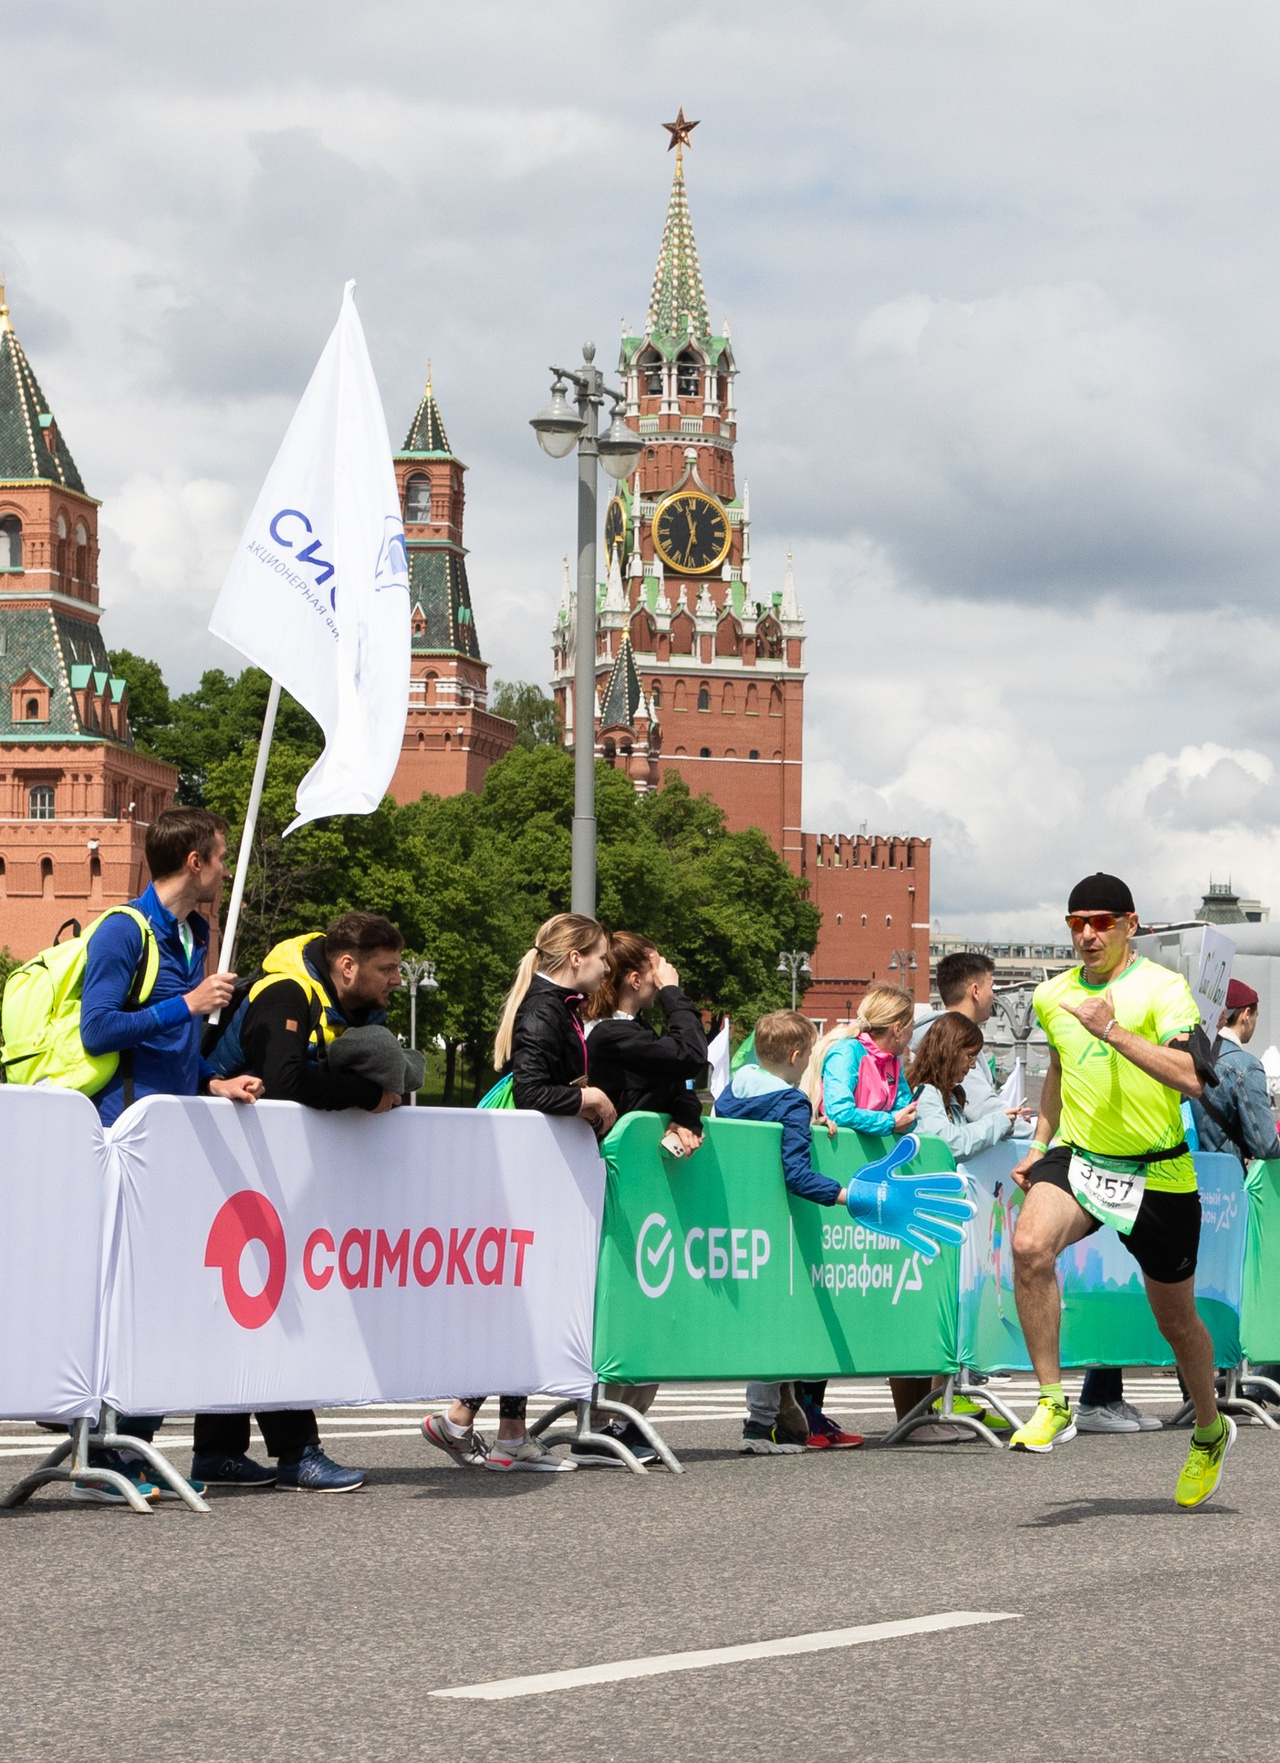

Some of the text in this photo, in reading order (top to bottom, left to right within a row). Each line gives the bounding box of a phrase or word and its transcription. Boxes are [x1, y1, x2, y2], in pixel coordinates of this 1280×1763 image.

[246, 540, 340, 642] АКЦИОНЕРНАЯ ФИ
[269, 508, 336, 613] СИ
[303, 1226, 535, 1291] самокат
[684, 1226, 771, 1280] СБЕР
[811, 1253, 893, 1297] марафон
